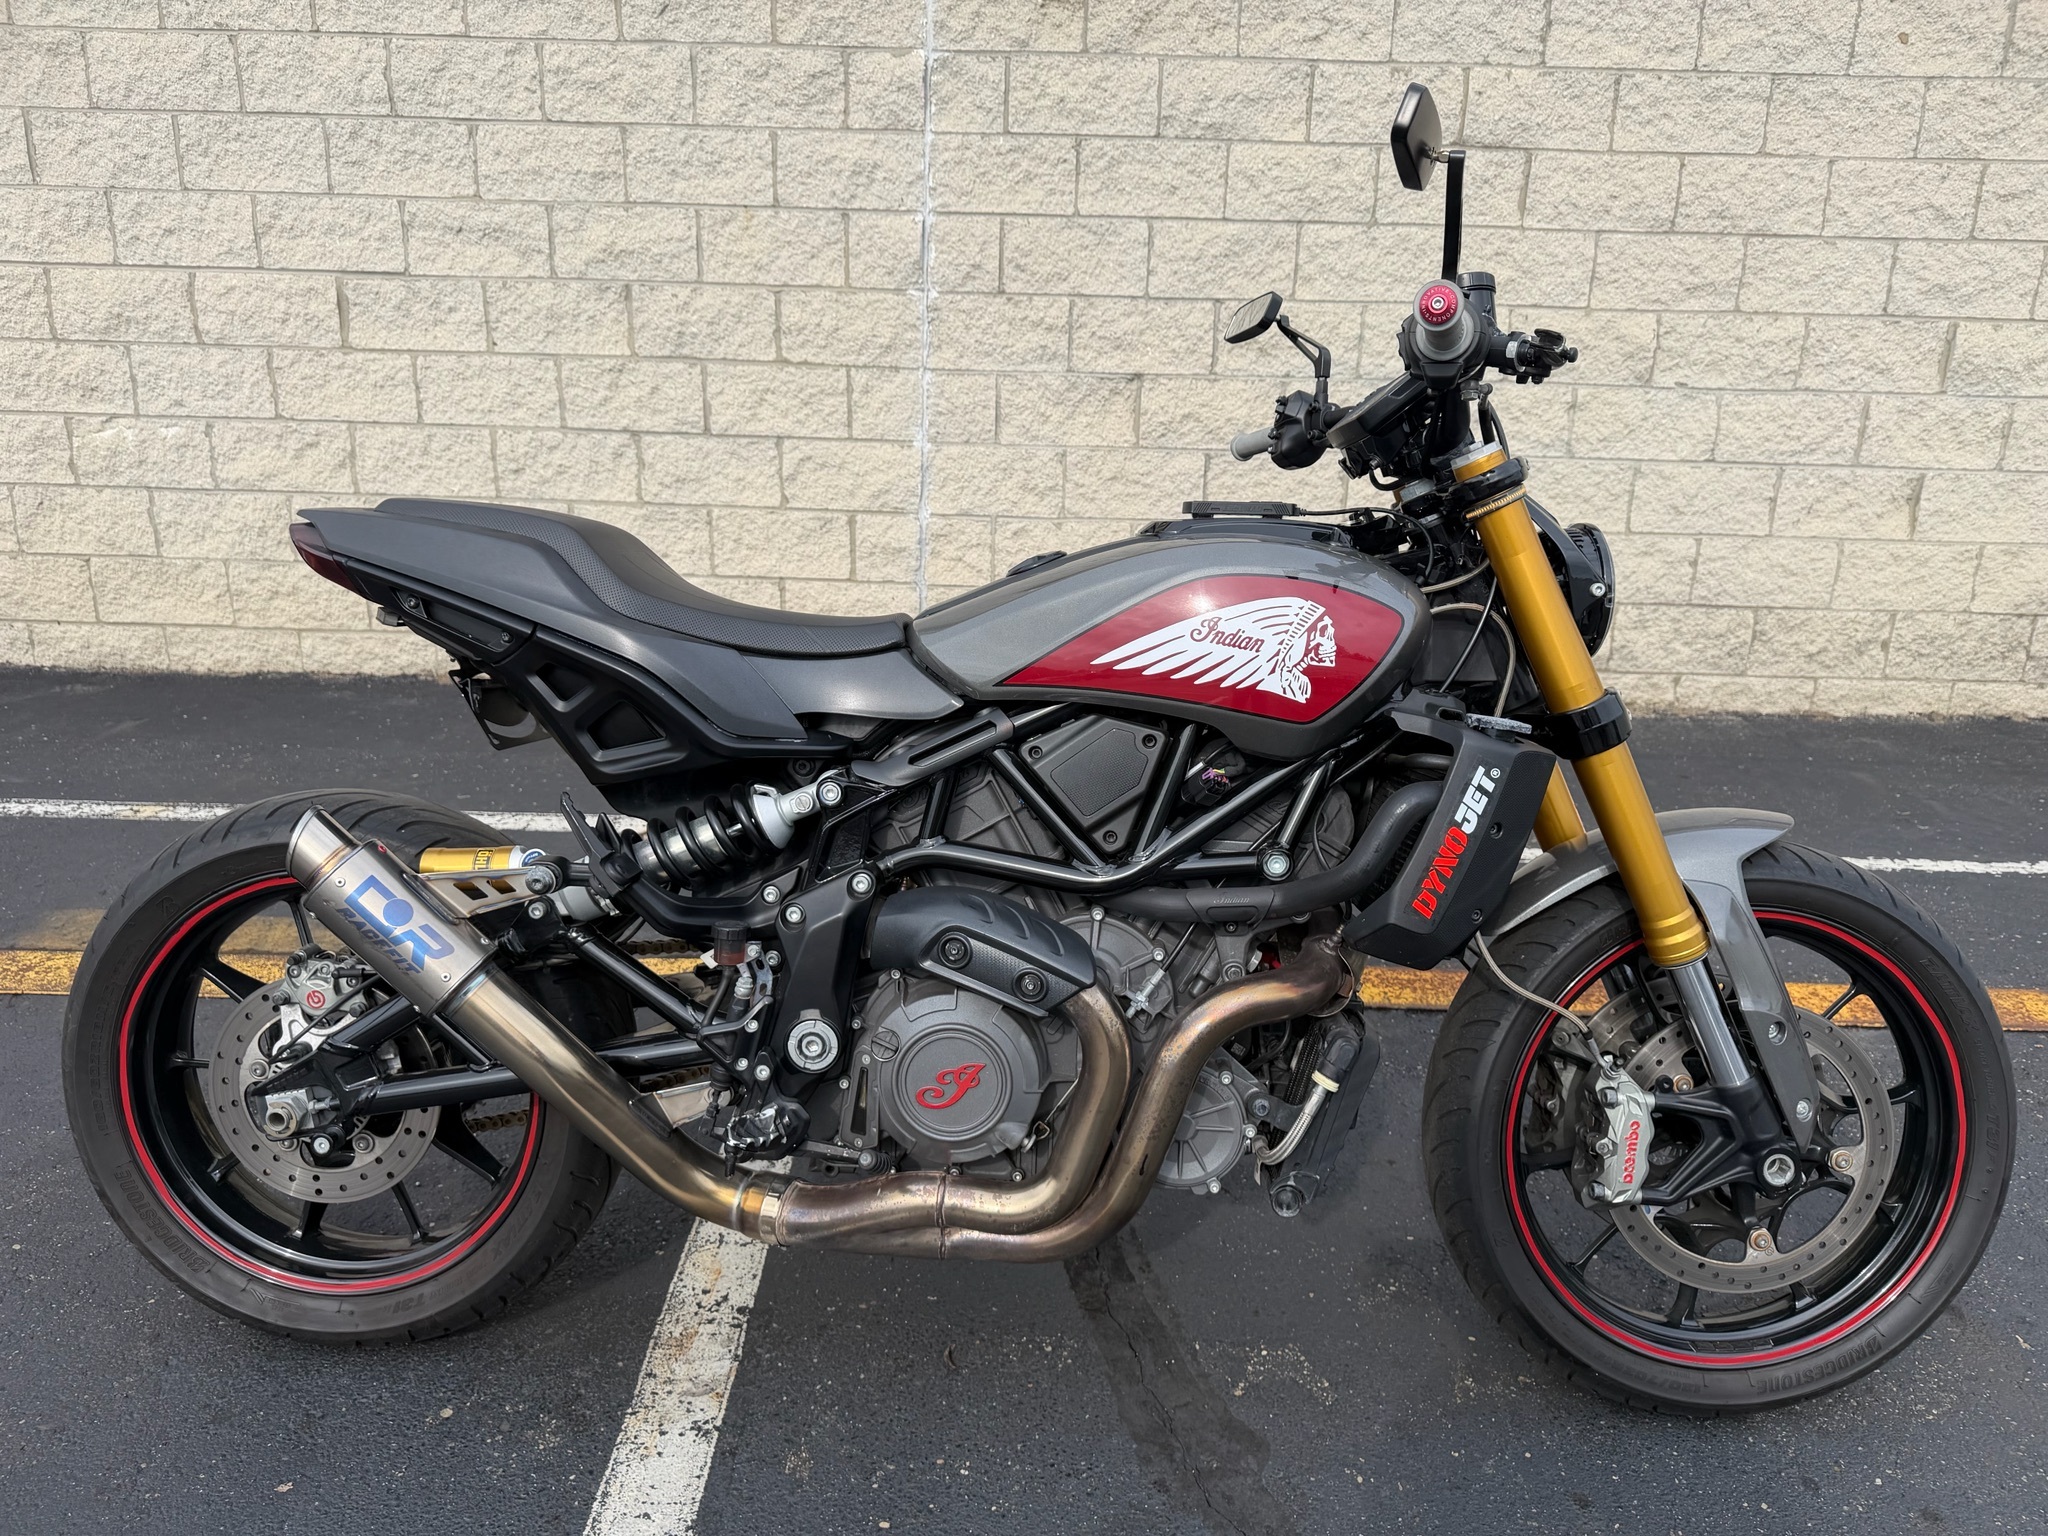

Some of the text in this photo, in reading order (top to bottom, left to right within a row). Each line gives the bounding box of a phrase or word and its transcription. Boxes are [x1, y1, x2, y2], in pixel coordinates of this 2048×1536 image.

[1425, 294, 1456, 322] COMPONENTS
[1190, 616, 1265, 653] Indian
[335, 907, 421, 976] RACEFIT
[114, 1168, 211, 1273] BRIDGESTONE
[1756, 1335, 1882, 1395] BRIDGESTONE
